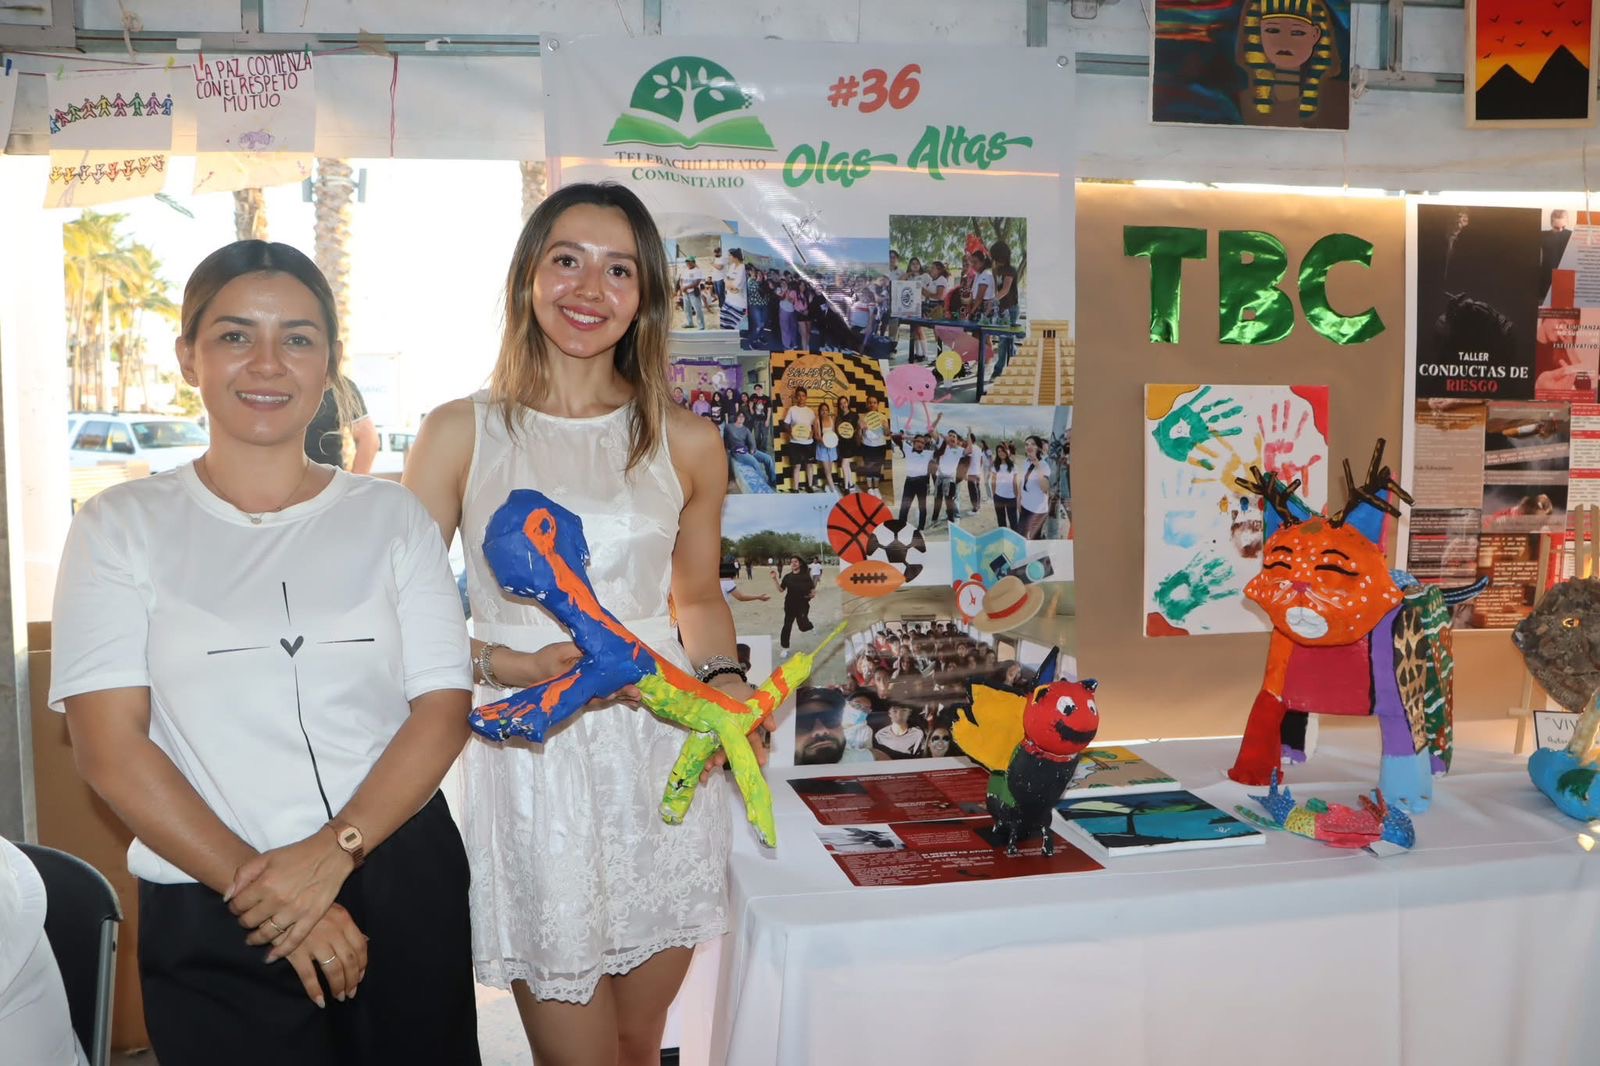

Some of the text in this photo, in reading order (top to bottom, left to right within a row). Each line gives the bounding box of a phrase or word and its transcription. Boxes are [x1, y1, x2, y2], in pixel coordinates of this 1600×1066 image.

[193, 52, 312, 81] LA PAZ COMIENZA
[196, 72, 298, 99] CON EL RESPETO
[827, 63, 922, 113] #36
[223, 93, 281, 112] MUTUO
[615, 150, 767, 171] TELEBACHILLERATO
[782, 124, 1033, 188] Olas Altas
[631, 167, 745, 188] COMUNITARIO
[1123, 225, 1386, 345] TBC
[1458, 351, 1490, 362] TALLER
[1418, 363, 1529, 378] CONDUCTAS DE
[1446, 379, 1499, 393] RIESGO
